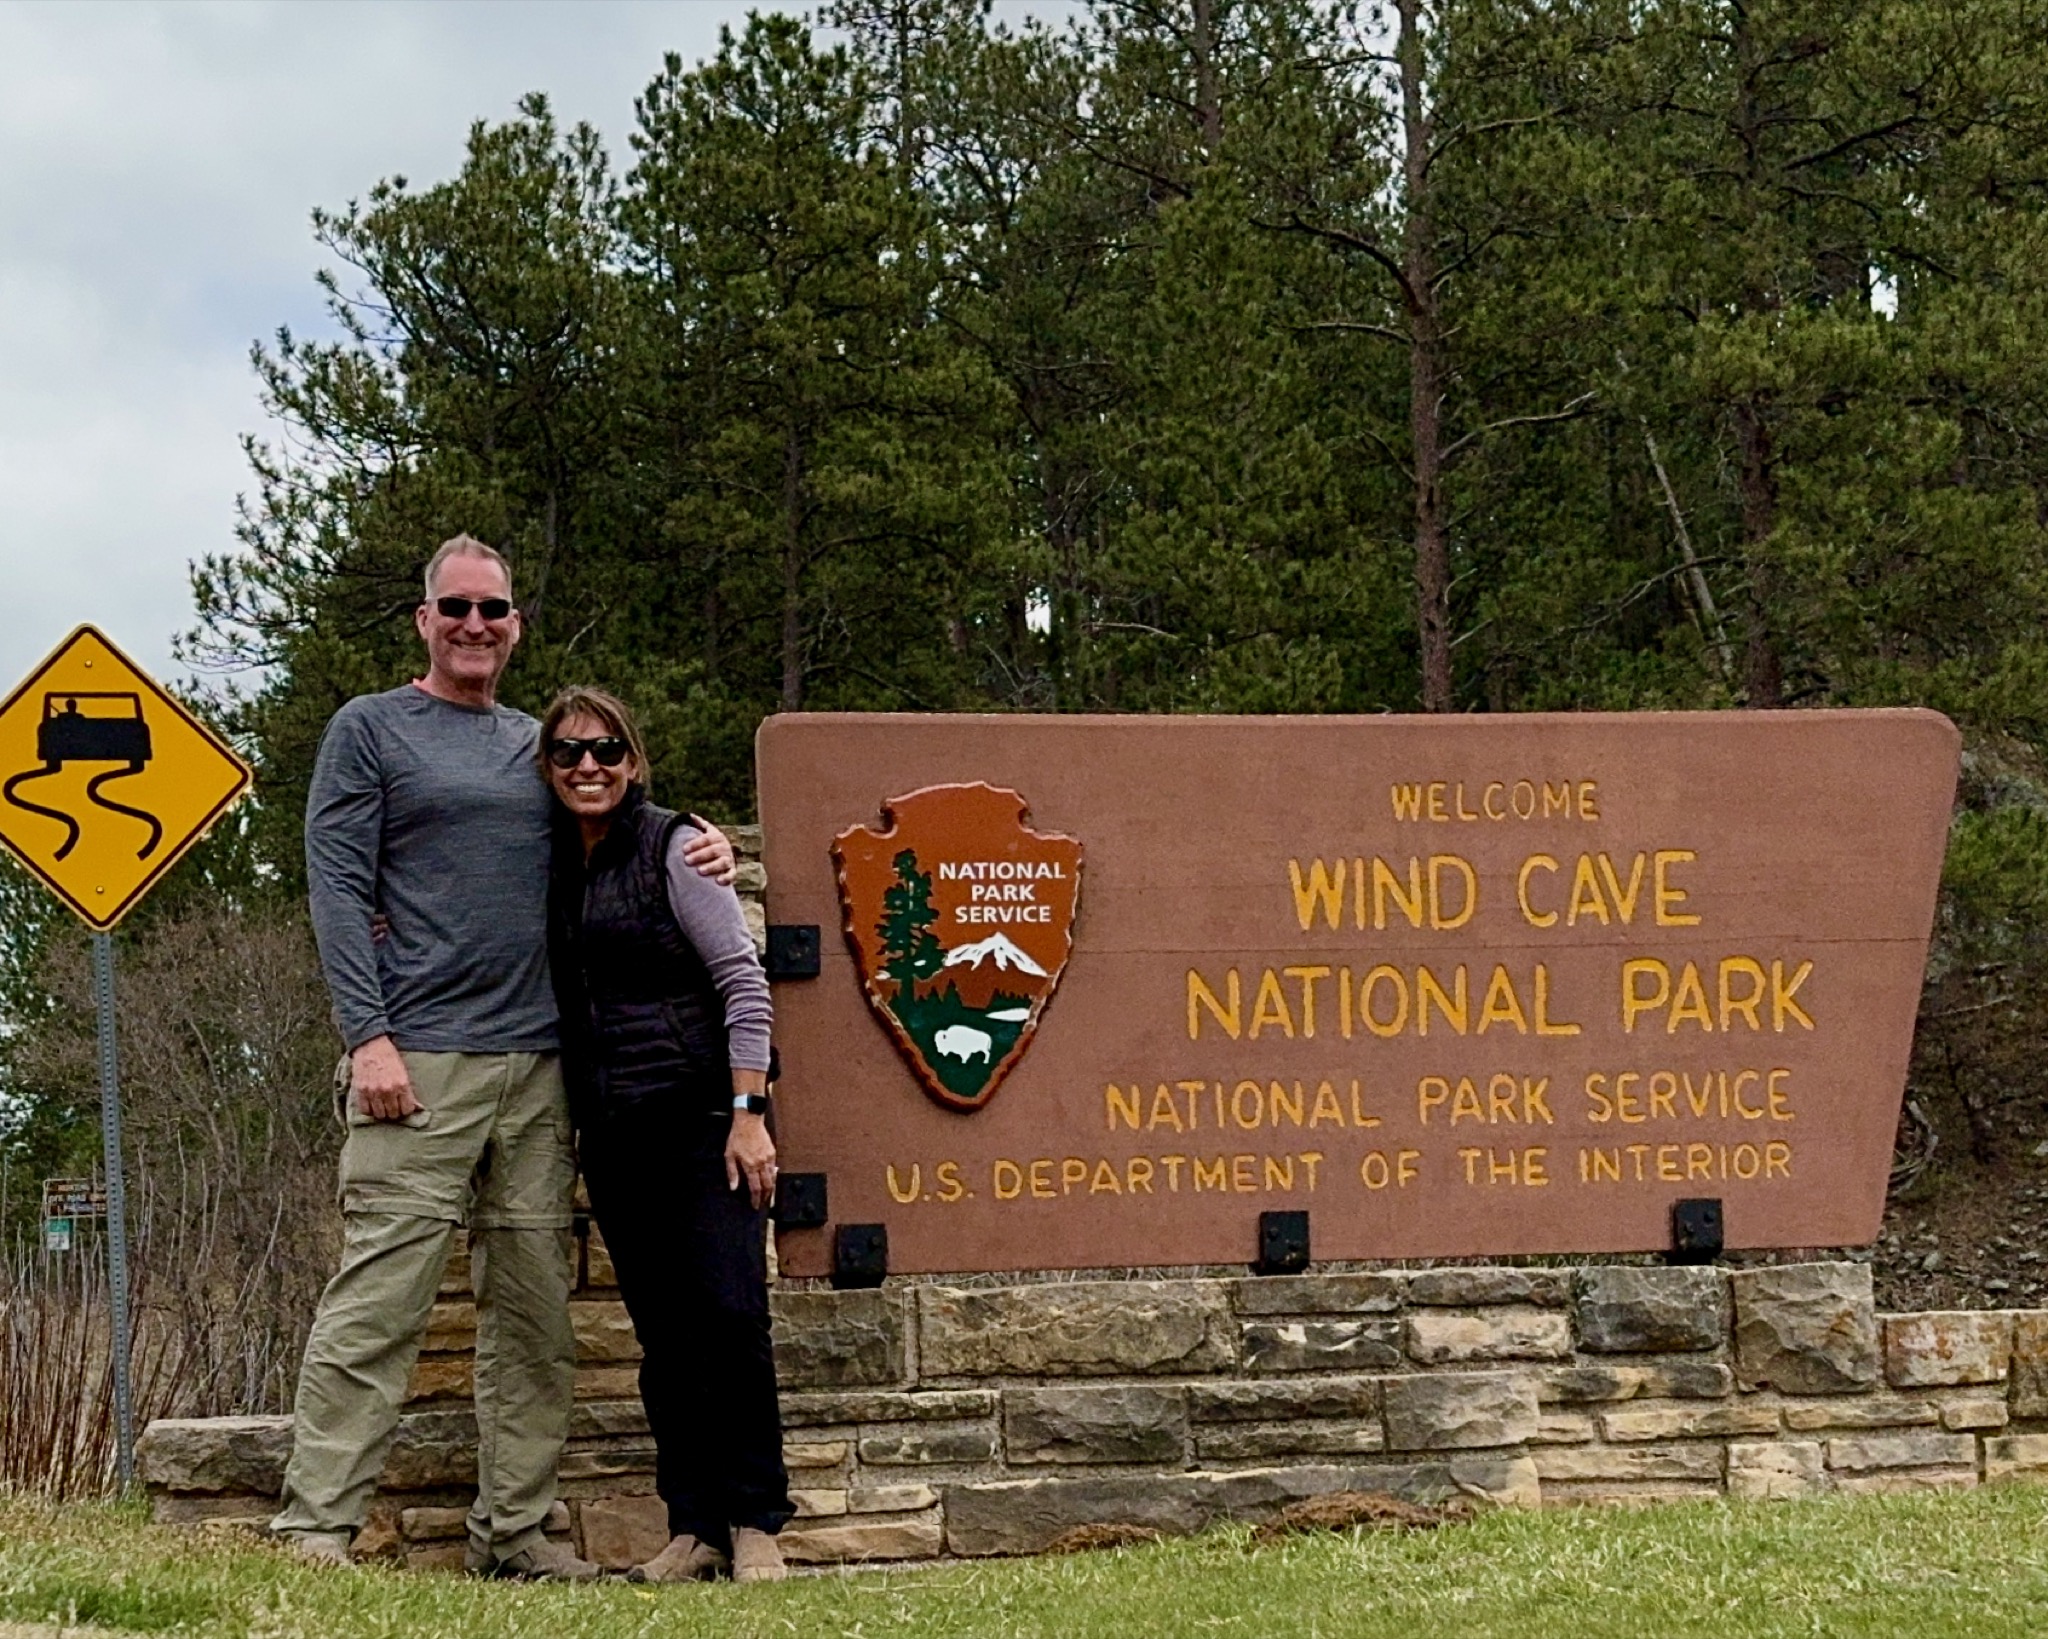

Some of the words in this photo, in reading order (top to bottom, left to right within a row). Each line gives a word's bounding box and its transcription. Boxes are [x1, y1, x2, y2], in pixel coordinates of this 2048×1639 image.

[1391, 780, 1600, 821] WELCOME
[939, 862, 1066, 880] NATIONAL
[971, 884, 1035, 902] PARK
[1288, 854, 1479, 930] WIND
[1517, 850, 1701, 929] CAVE
[955, 905, 1051, 923] SERVICE
[1186, 964, 1581, 1039] NATIONAL
[1621, 955, 1816, 1034] PARK
[1104, 1080, 1380, 1133] NATIONAL
[1418, 1074, 1556, 1124] PARK
[1585, 1069, 1794, 1124] SERVICE
[887, 1162, 975, 1203] U.S.
[993, 1153, 1323, 1200] DEPARTMENT
[1361, 1149, 1420, 1190] OF
[1457, 1148, 1549, 1189] THE
[1579, 1142, 1791, 1182] INTERIOR
